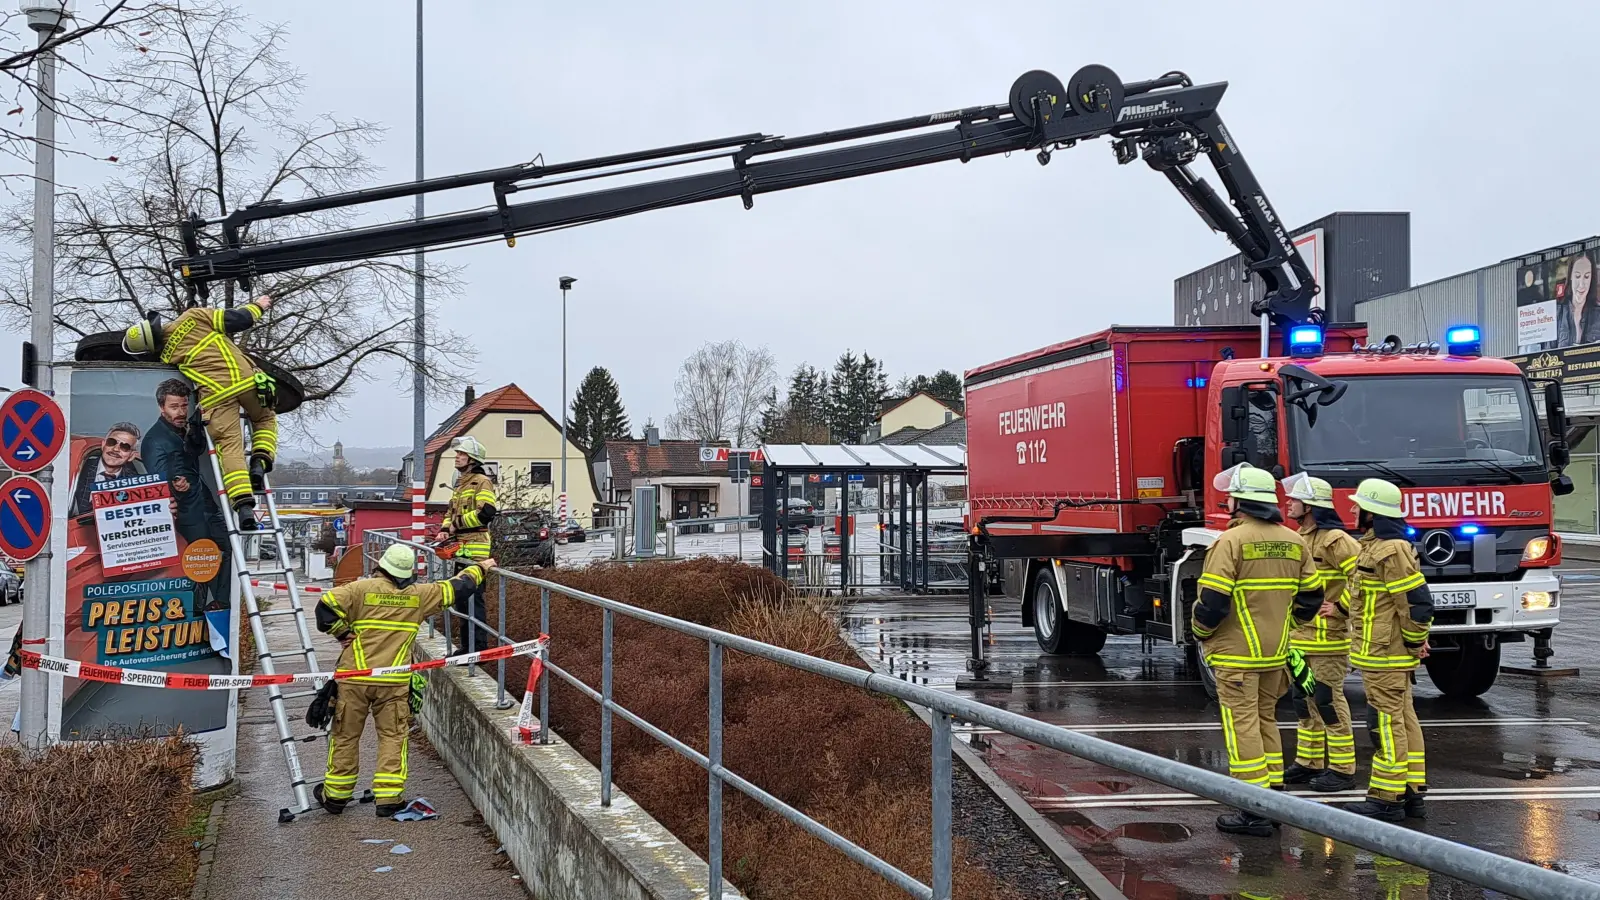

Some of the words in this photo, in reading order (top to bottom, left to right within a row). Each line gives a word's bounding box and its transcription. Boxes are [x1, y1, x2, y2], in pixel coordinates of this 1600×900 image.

[1117, 100, 1170, 122] Albert
[1254, 195, 1275, 223] ATLAS
[1519, 319, 1537, 327] sparen
[999, 402, 1066, 435] FEUERWEHR
[1028, 439, 1047, 464] 112
[96, 473, 160, 490] TESTSIEGER
[105, 503, 162, 520] BESTER
[101, 523, 172, 541] VERSICHERER
[124, 518, 146, 528] KFZ-
[106, 535, 170, 550] Serviceversicherer
[87, 580, 166, 597] POLEPOSITION
[169, 577, 192, 589] FÜR:
[1441, 593, 1449, 604] S
[1451, 592, 1471, 604] 158
[88, 597, 163, 627] PREIS
[165, 598, 185, 619] &
[105, 620, 209, 654] LEISTUN
[104, 659, 117, 667] Die
[119, 651, 187, 666] Autoversicherung
[188, 649, 200, 657] der
[80, 666, 173, 687] FEUERWEHR-SPERRZONE
